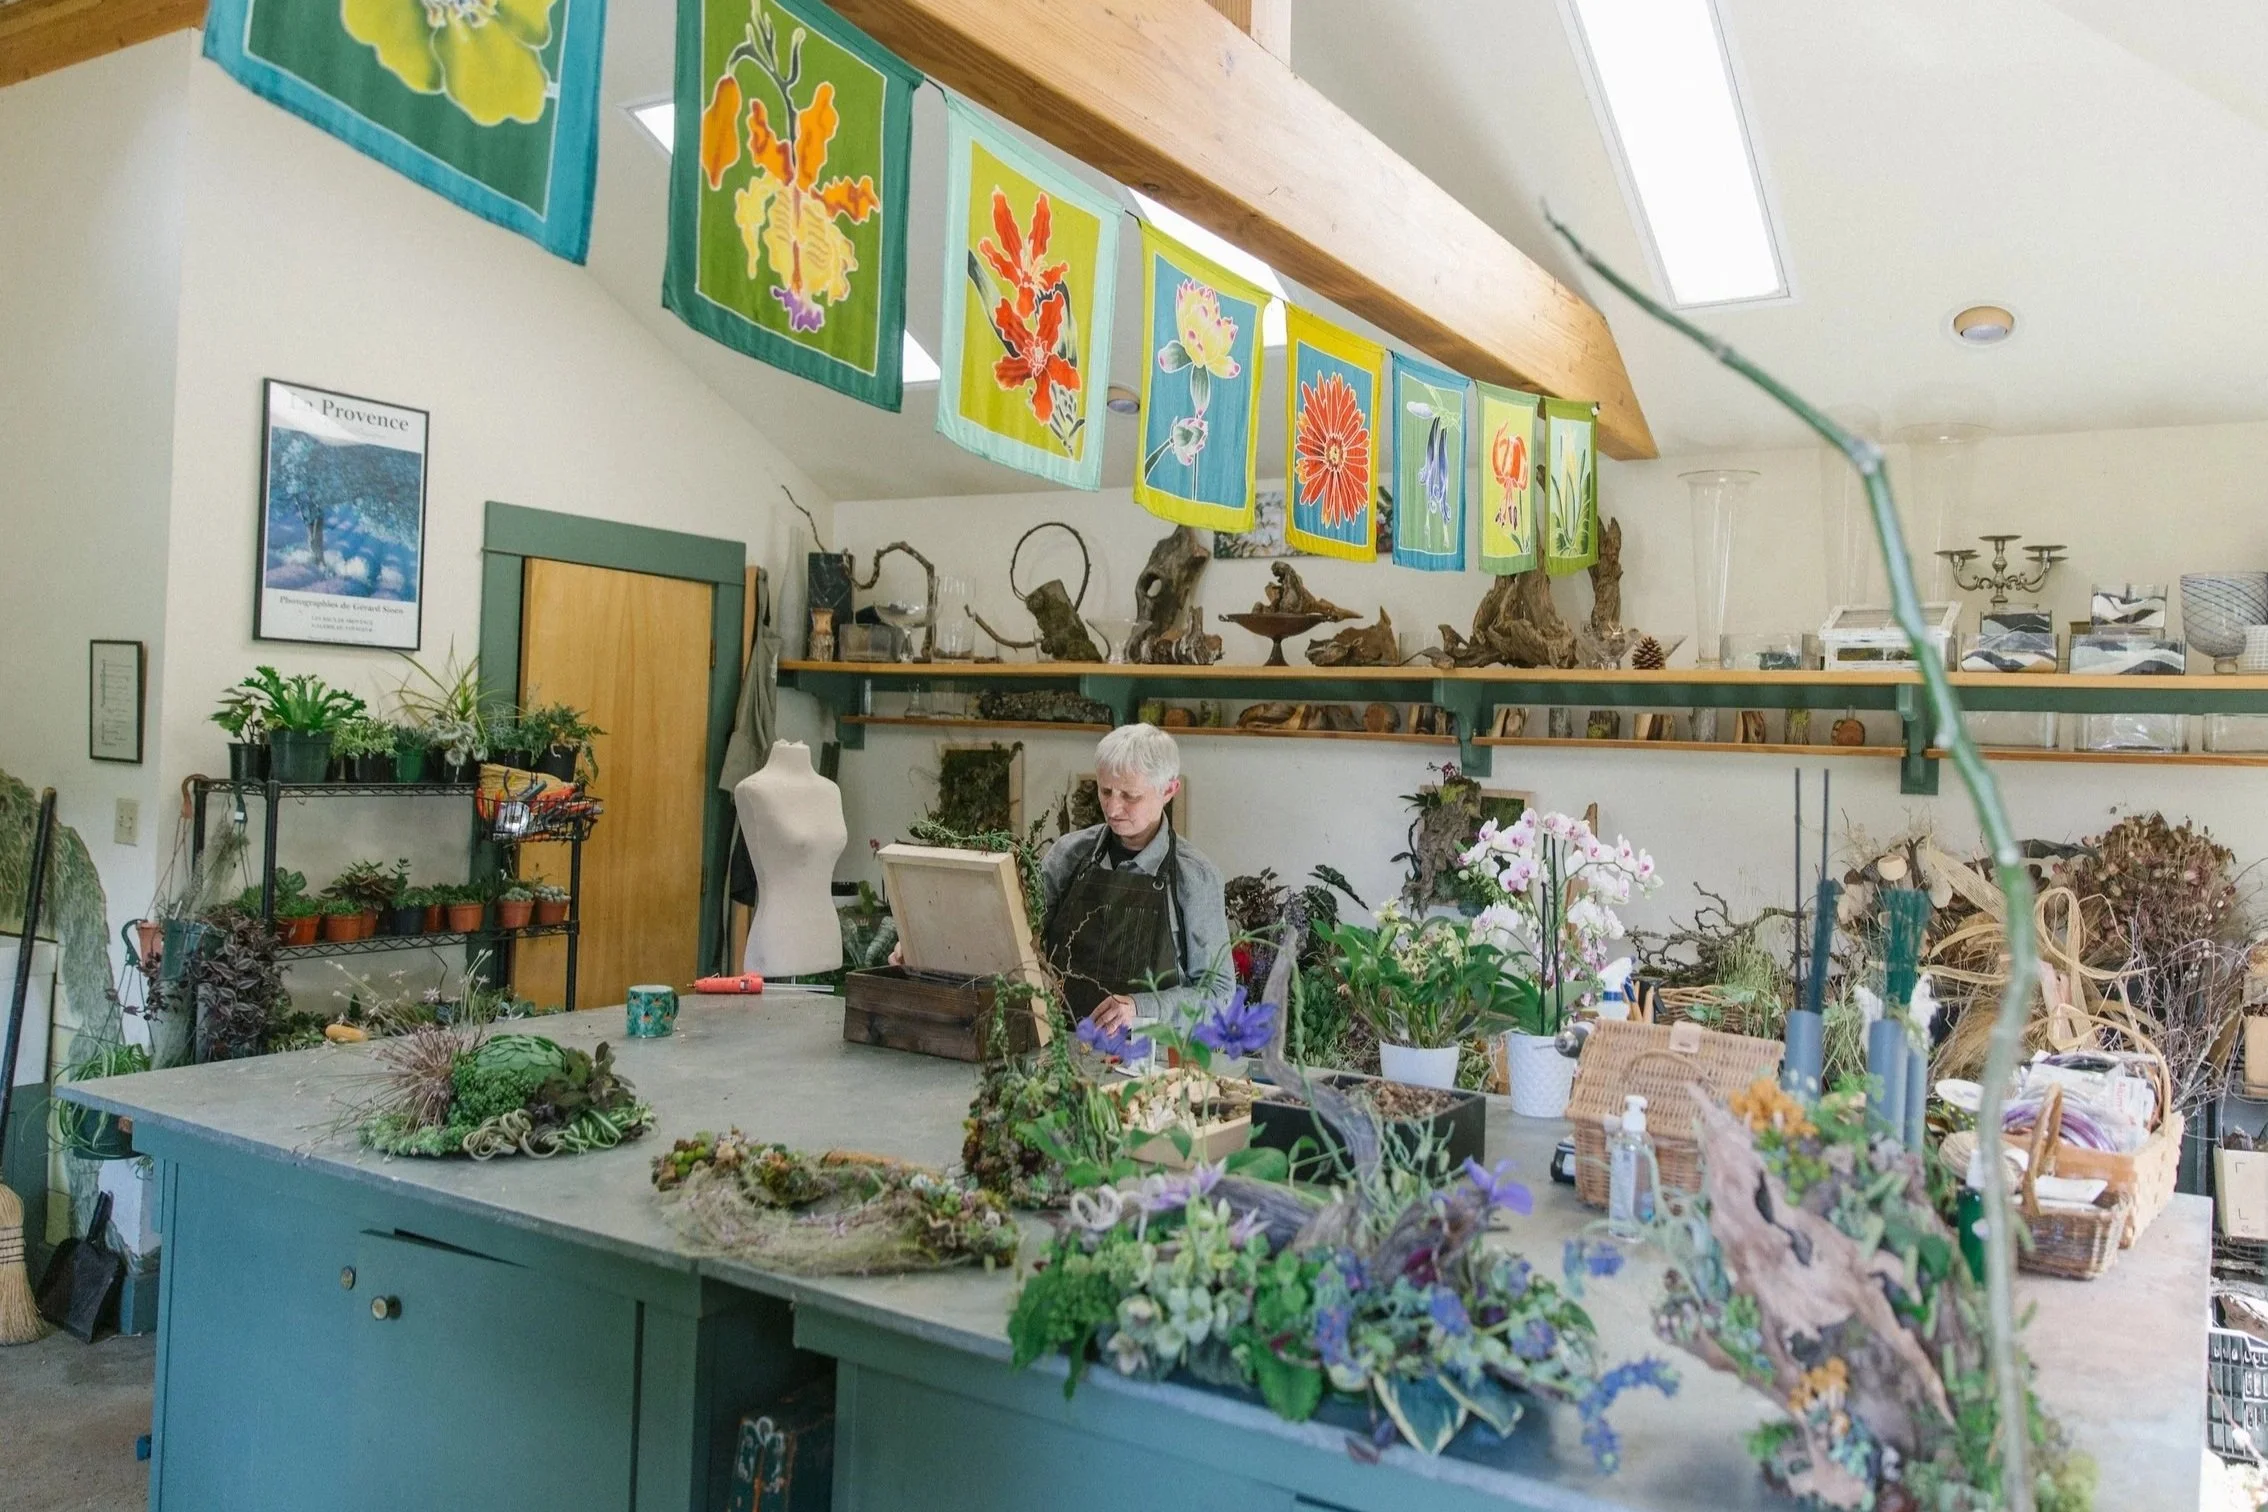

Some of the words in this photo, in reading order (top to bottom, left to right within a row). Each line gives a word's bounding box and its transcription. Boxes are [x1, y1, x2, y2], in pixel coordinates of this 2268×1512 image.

[322, 399, 409, 431] Provence
[280, 595, 338, 609] Photographies
[340, 601, 351, 609] de
